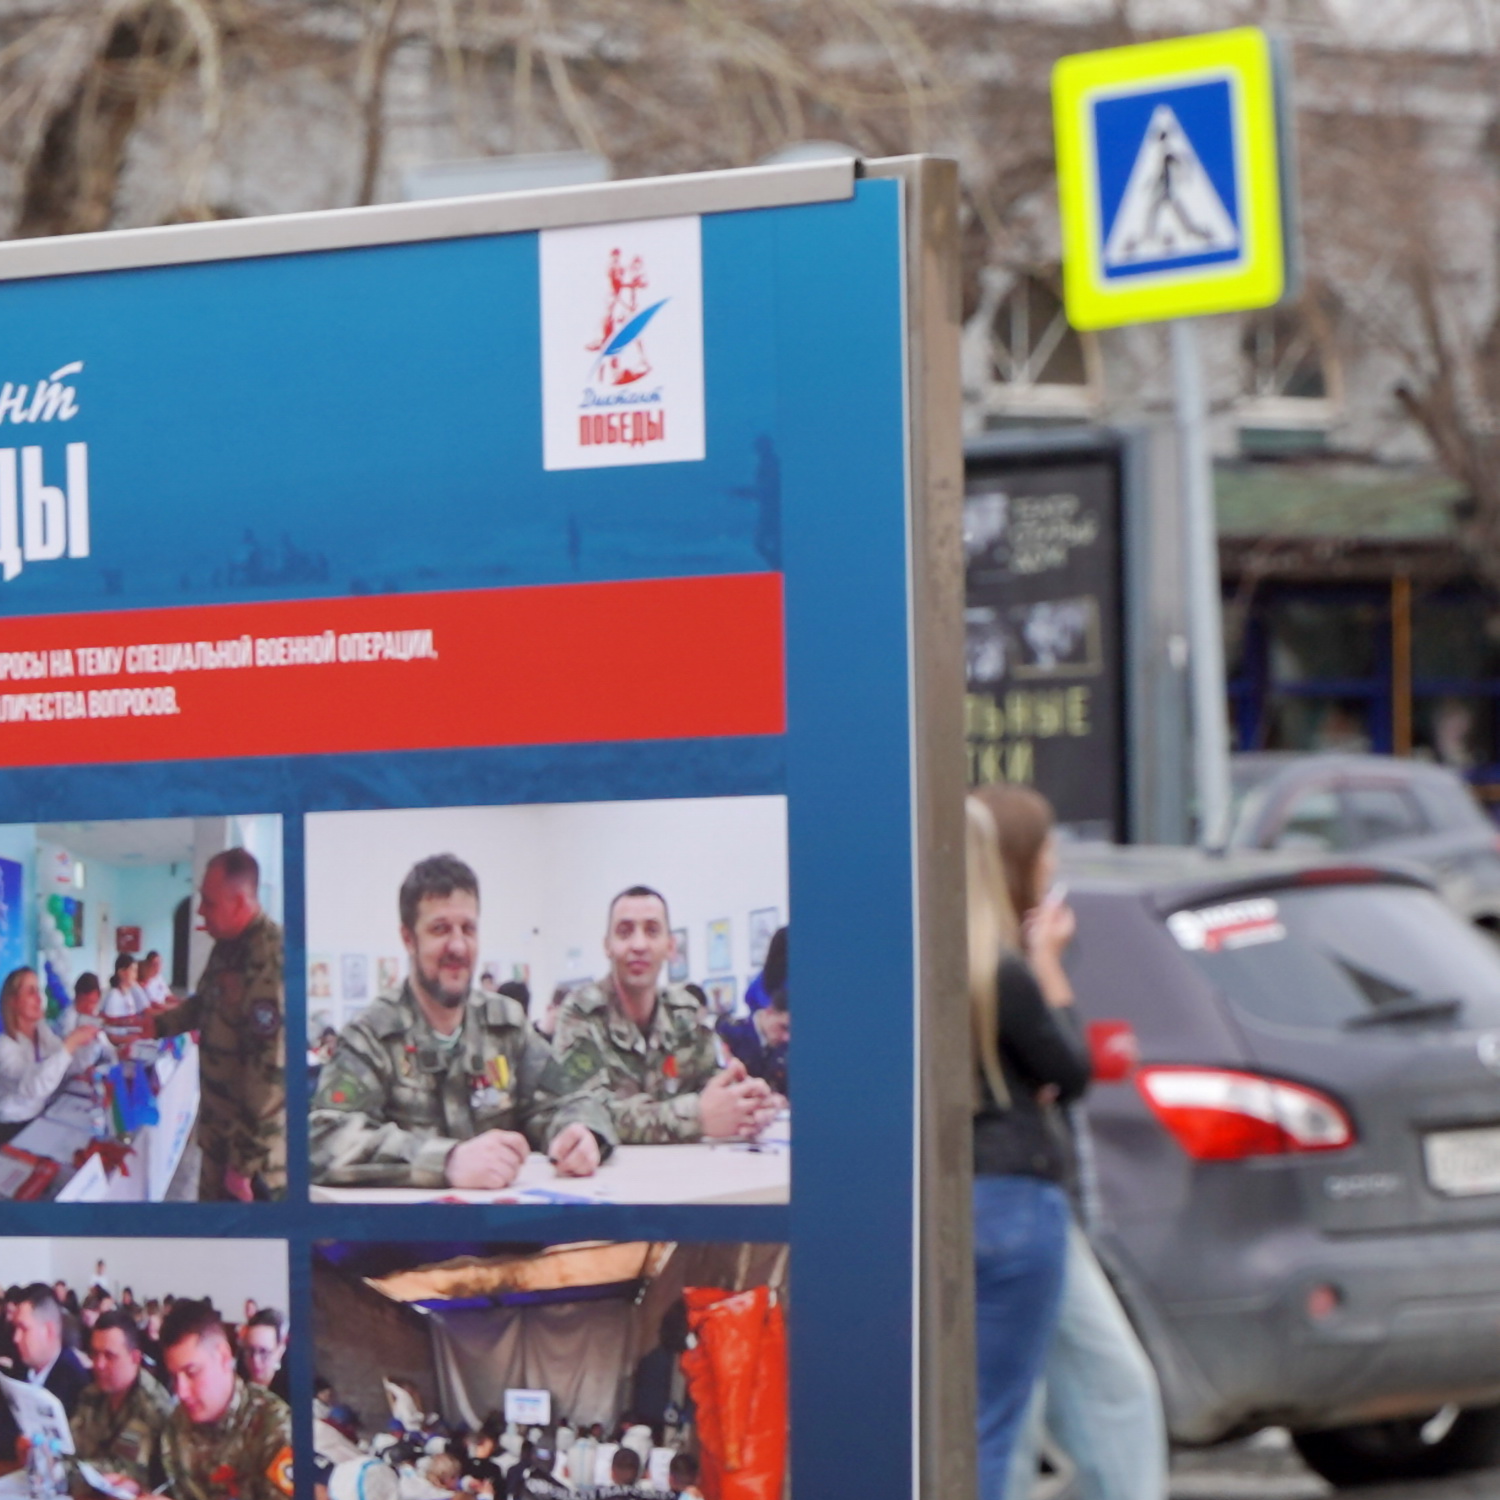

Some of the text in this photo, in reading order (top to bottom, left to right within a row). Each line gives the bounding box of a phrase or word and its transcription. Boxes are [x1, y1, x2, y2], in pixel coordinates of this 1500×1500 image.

[579, 409, 664, 447] ПОБЕДЫ
[50, 649, 74, 677] НА
[75, 646, 125, 676] ТЕМУ
[126, 634, 252, 673] СПЕЦИАЛЬНОЙ
[255, 630, 335, 667] ВОЕННОЙ
[338, 629, 438, 662] ОПЕРАЦИИ,
[88, 686, 180, 717] ВОПРОСОВ.
